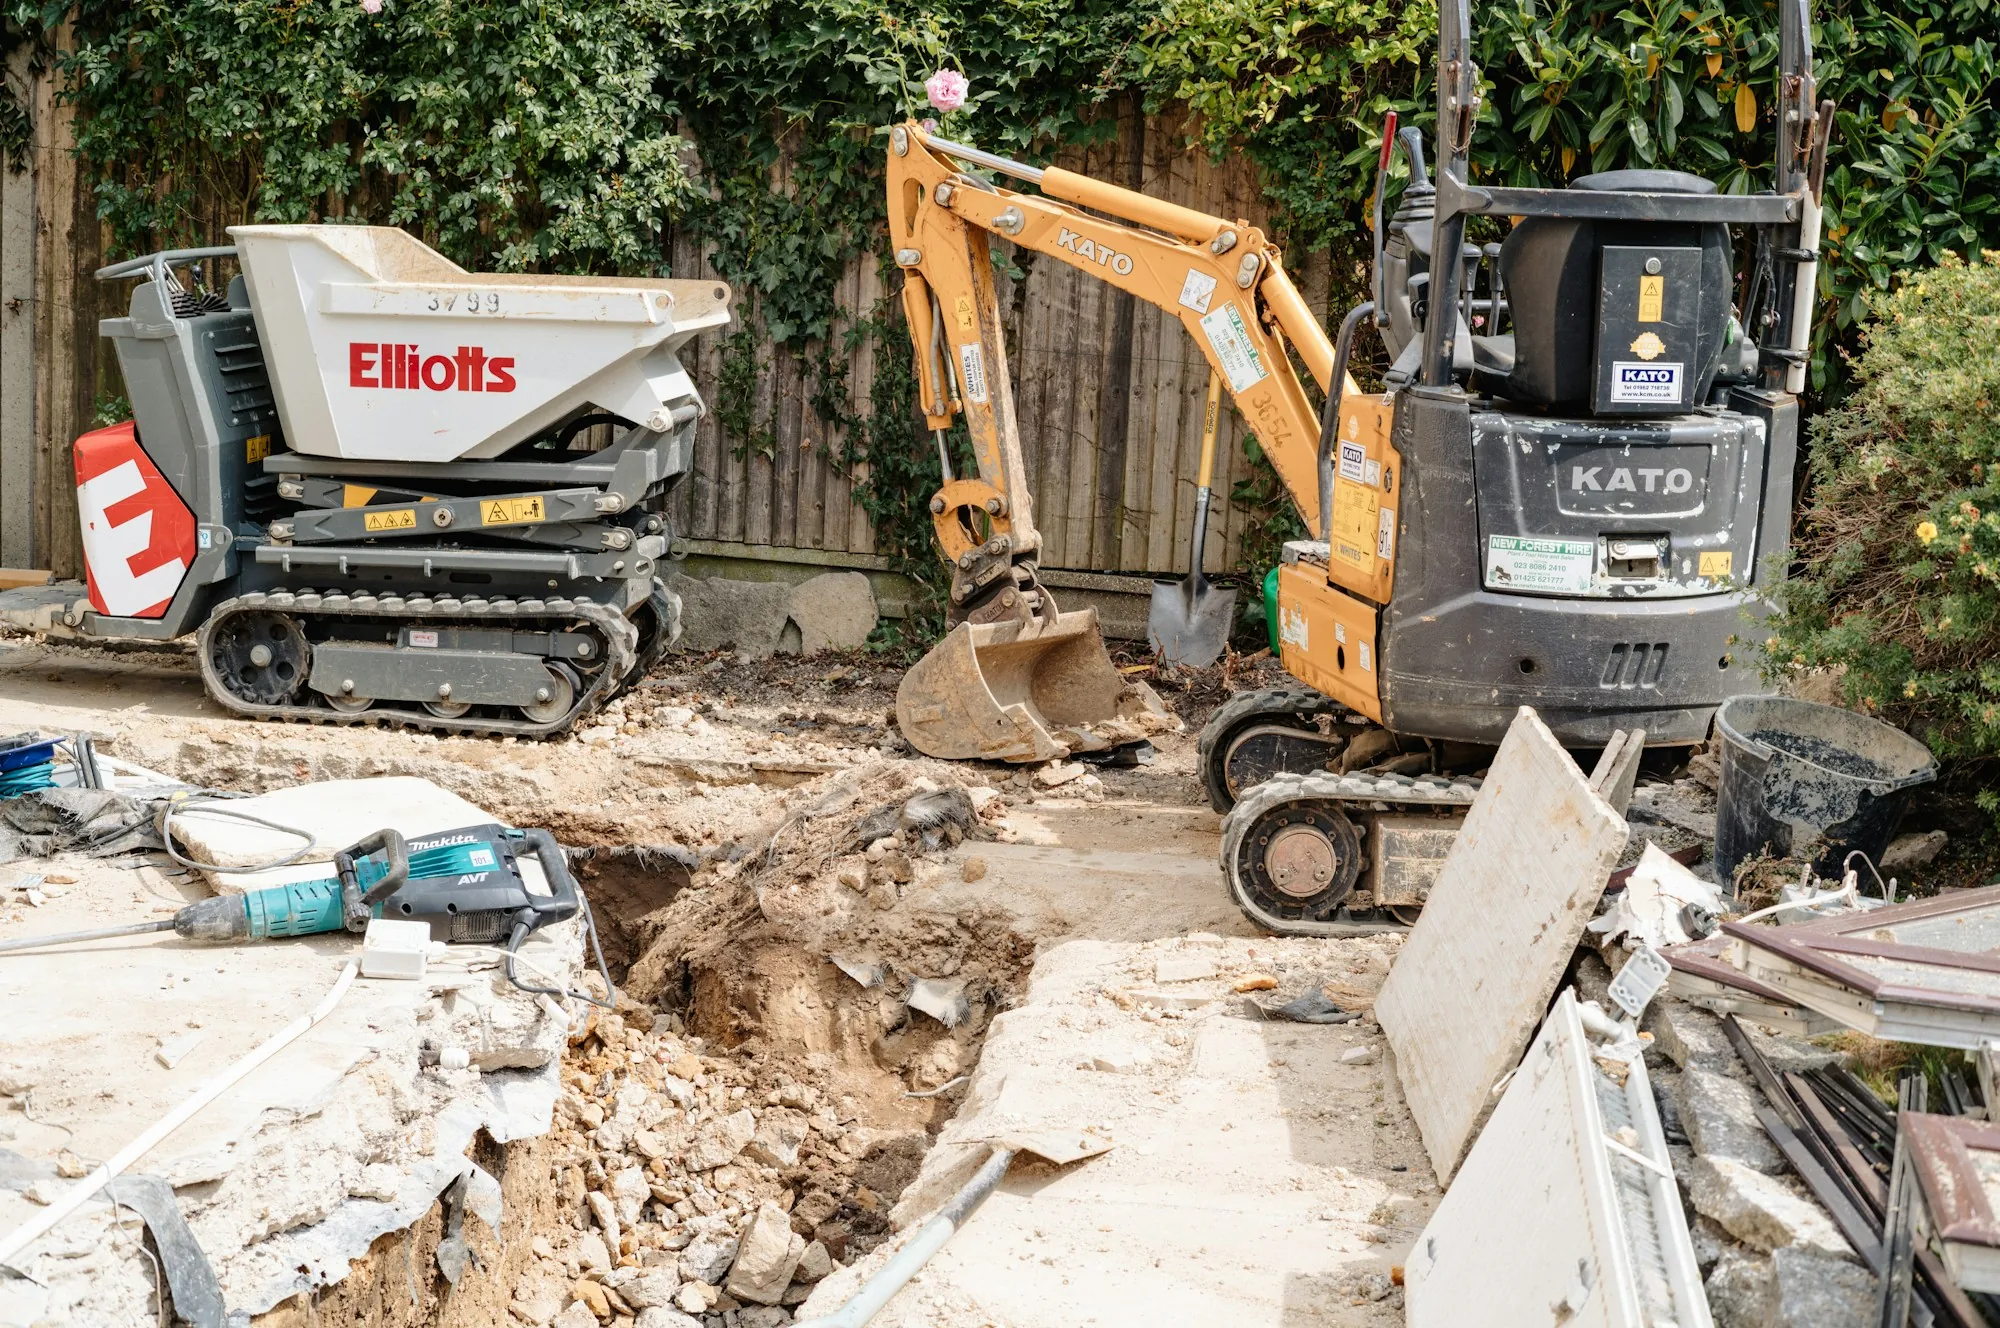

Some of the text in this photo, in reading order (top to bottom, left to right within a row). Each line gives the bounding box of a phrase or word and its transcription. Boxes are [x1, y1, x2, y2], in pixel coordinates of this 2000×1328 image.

[1056, 226, 1134, 276] KATO
[1234, 322, 1258, 357] FOREST
[1251, 355, 1268, 377] HIRE
[349, 342, 517, 393] Elliotts
[964, 355, 975, 394] WHITES
[1624, 370, 1670, 382] KATO
[1343, 447, 1361, 463] KATO
[1572, 466, 1693, 493] KATO
[1340, 544, 1360, 561] WHITES
[1491, 537, 1591, 555] NEW FOREST HIRE
[1548, 564, 1566, 572] 2410
[1514, 574, 1536, 582] 01425
[1538, 575, 1564, 584] 621777
[474, 857, 487, 865] 101
[457, 872, 489, 885] AVT
